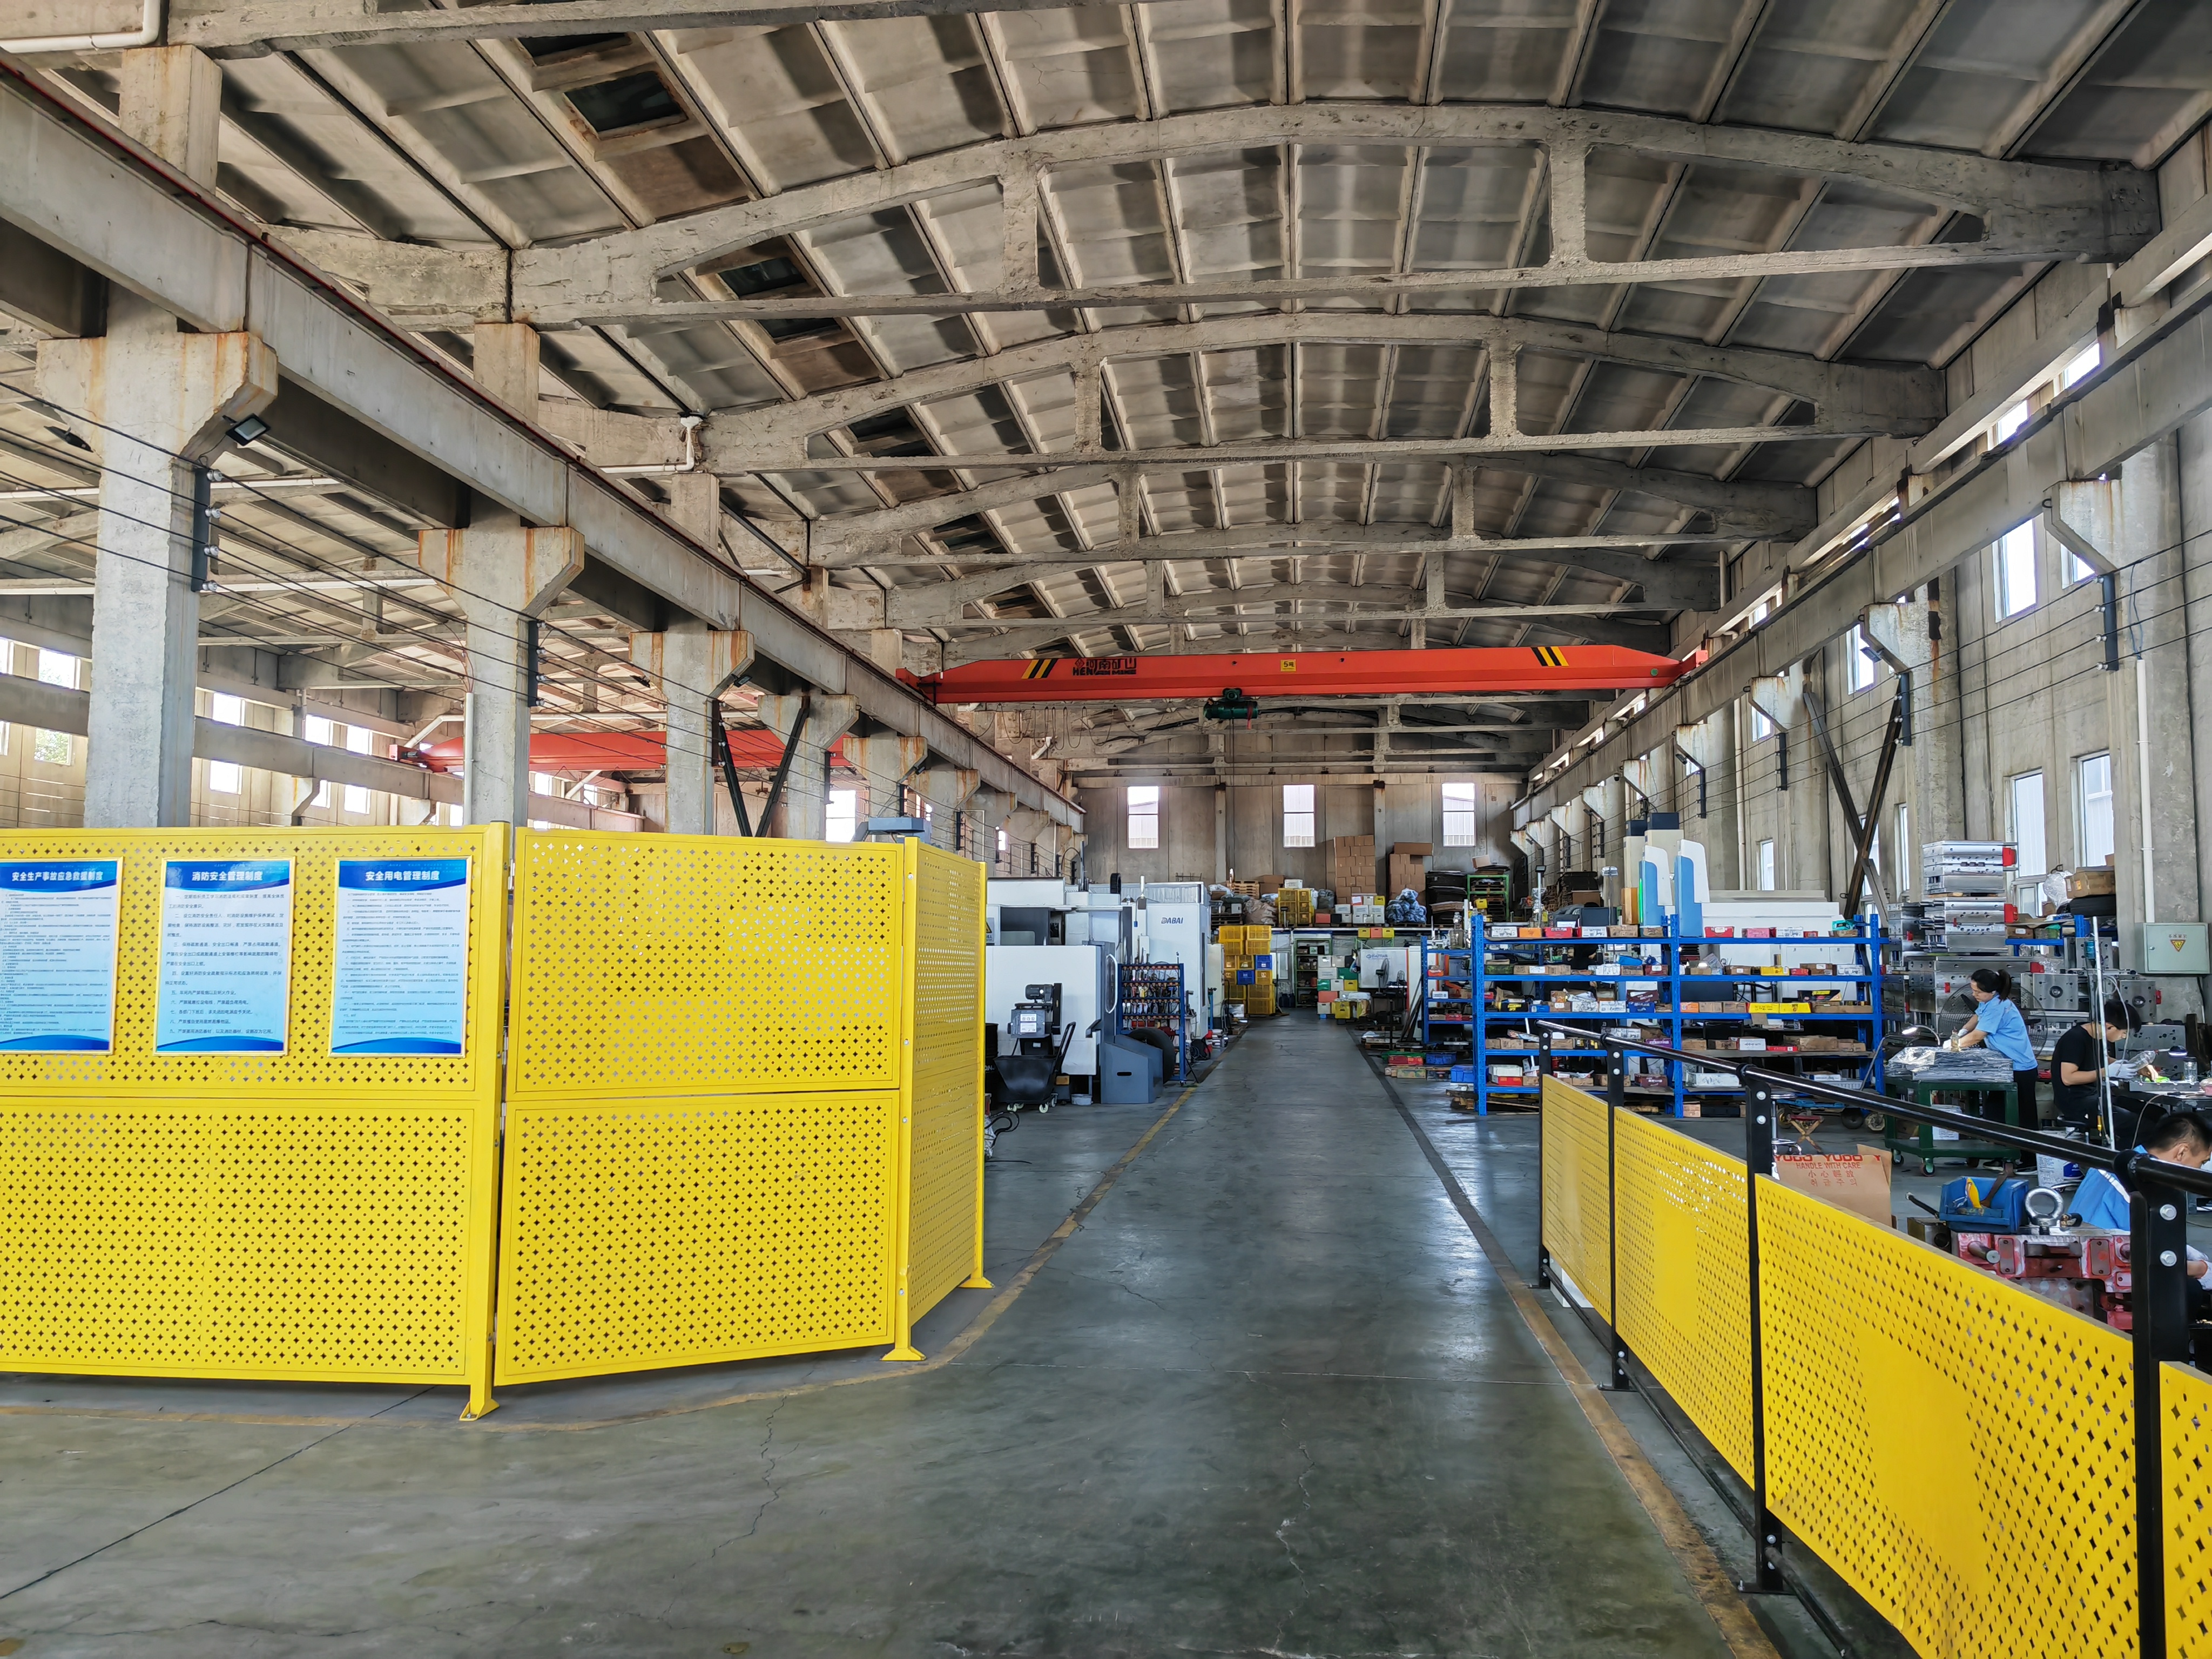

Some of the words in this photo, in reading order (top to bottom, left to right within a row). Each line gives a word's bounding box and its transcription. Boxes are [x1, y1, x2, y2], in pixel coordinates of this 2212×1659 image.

[12, 871, 103, 881] 安全生产事故应急救援制度
[192, 871, 263, 881] 消防安全管理制度
[365, 871, 440, 881] 安全用电管理制度
[1811, 1178, 1857, 1186] 취급주의
